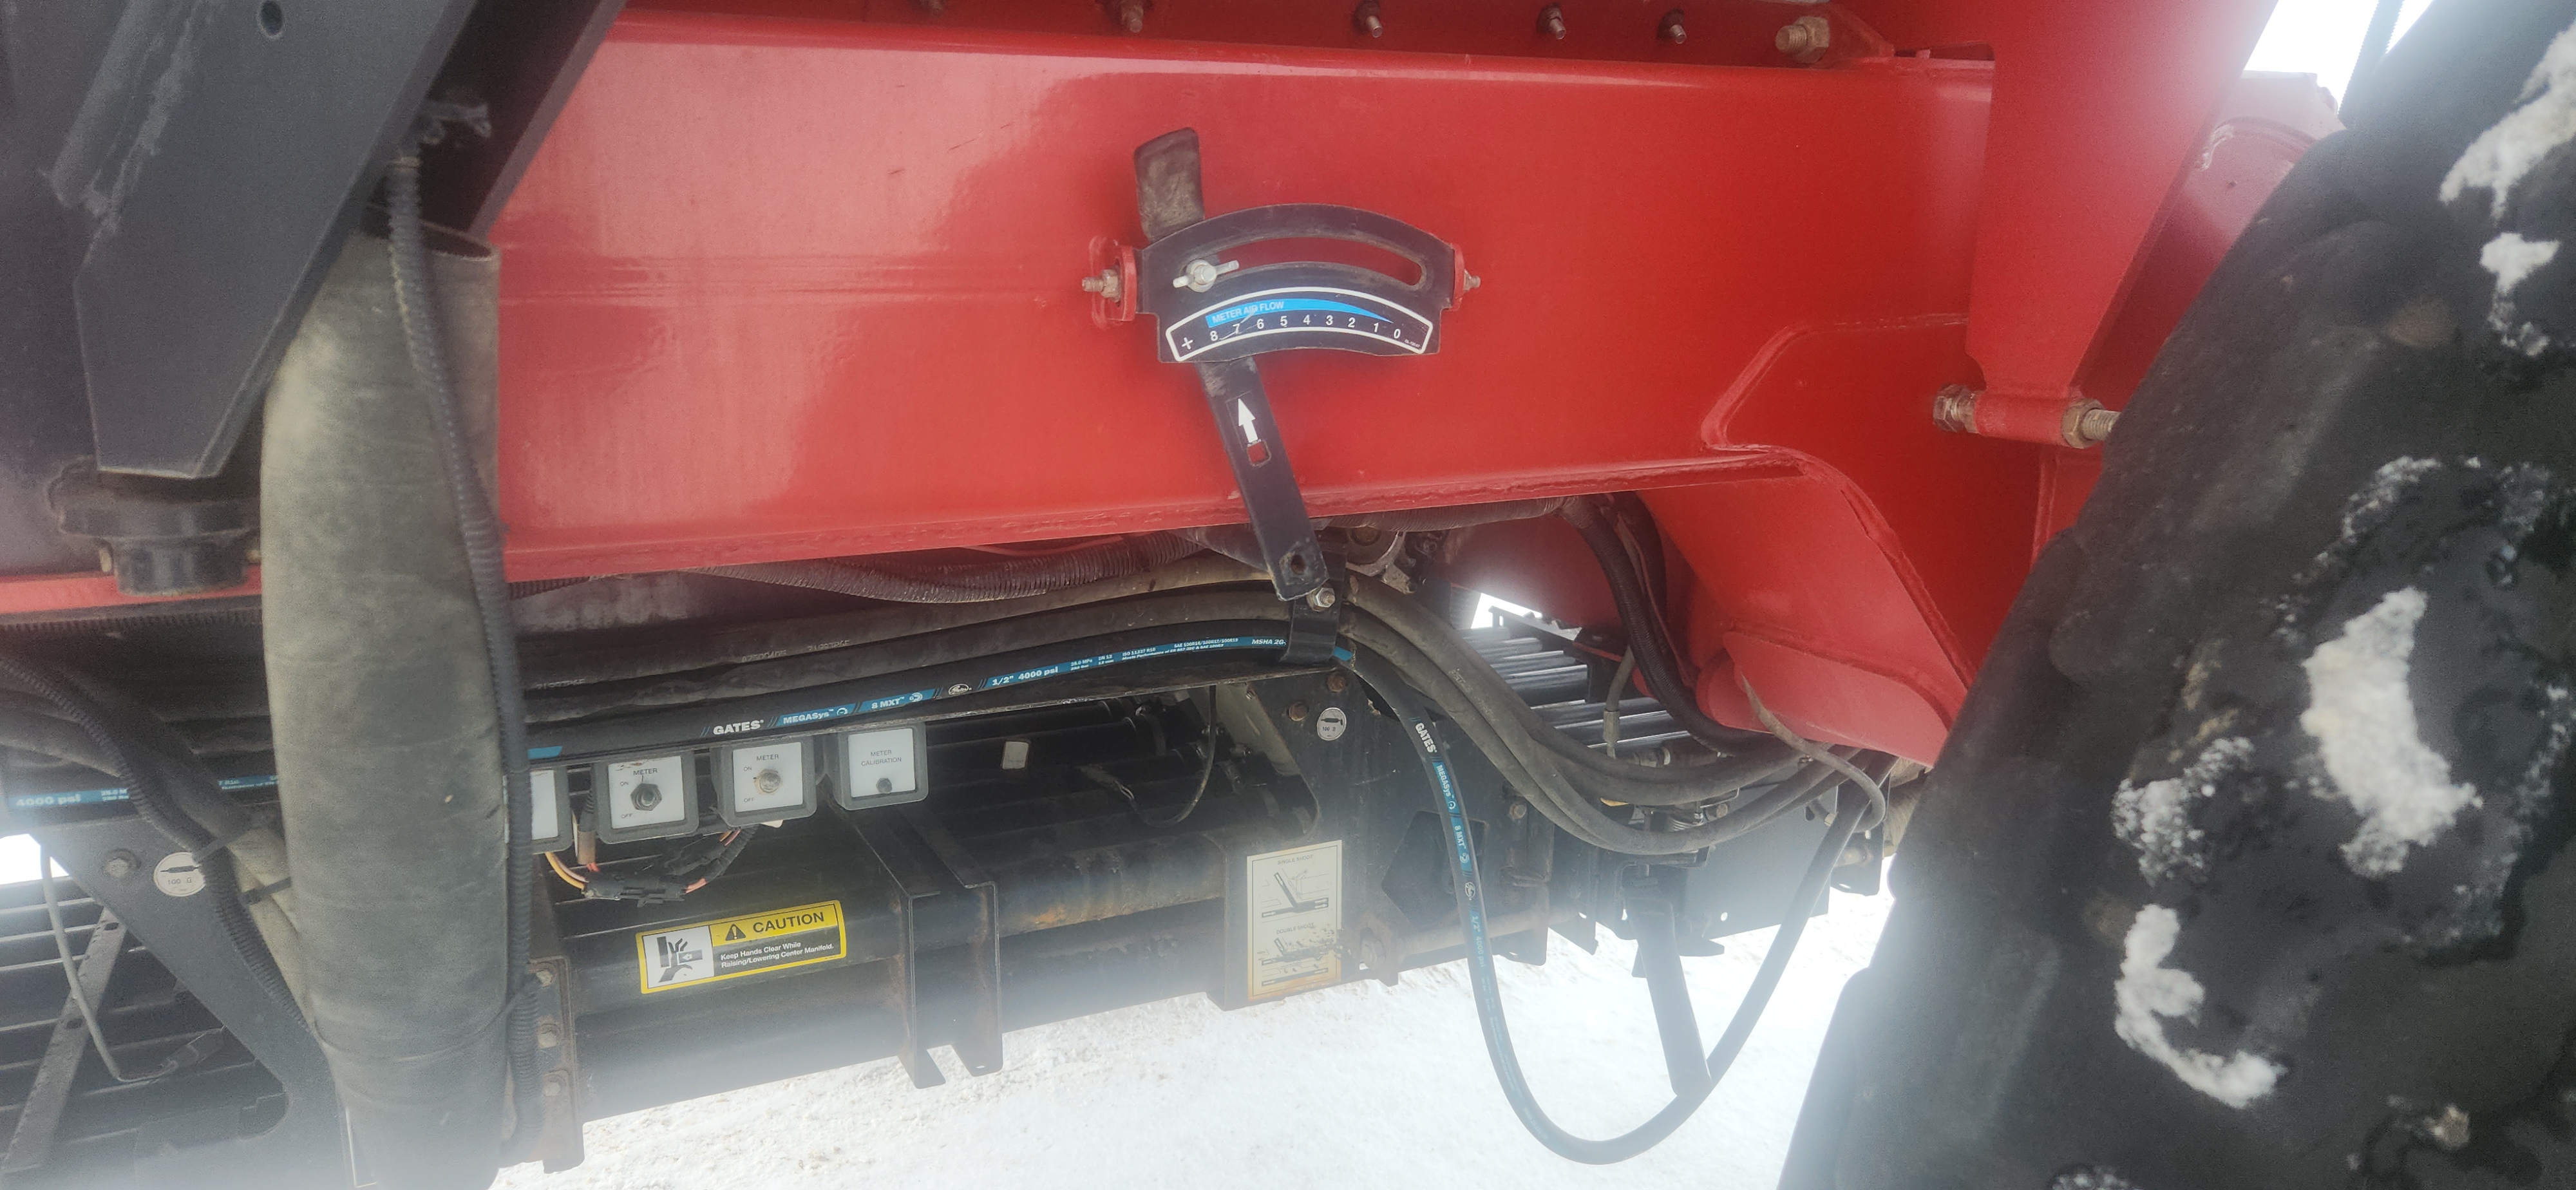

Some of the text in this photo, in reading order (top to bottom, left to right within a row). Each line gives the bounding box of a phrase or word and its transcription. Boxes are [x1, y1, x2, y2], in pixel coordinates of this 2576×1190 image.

[1212, 301, 1285, 323] METER AIR FLOW
[1209, 330, 1218, 341] 8
[1233, 323, 1240, 334] 7
[1256, 318, 1265, 329] 6
[1280, 316, 1288, 326] 5
[1303, 314, 1311, 325] 4
[1325, 314, 1334, 326] 3
[1347, 317, 1356, 328] 2
[1372, 322, 1379, 332] 1
[1394, 328, 1401, 339] 0
[992, 666, 1058, 686] 1/2" 4000 psi
[861, 757, 902, 766] CALIBRATION
[16, 795, 55, 806] 4000
[58, 793, 81, 805] psi
[1277, 857, 1295, 865] SINGLE
[753, 912, 825, 933] CAUTION
[1276, 926, 1296, 934] DOUBLE
[721, 941, 801, 961] Keep Hands Clear While
[721, 943, 834, 968] Raising/Lowering Center Manifold.
[1477, 956, 1486, 967] psi
